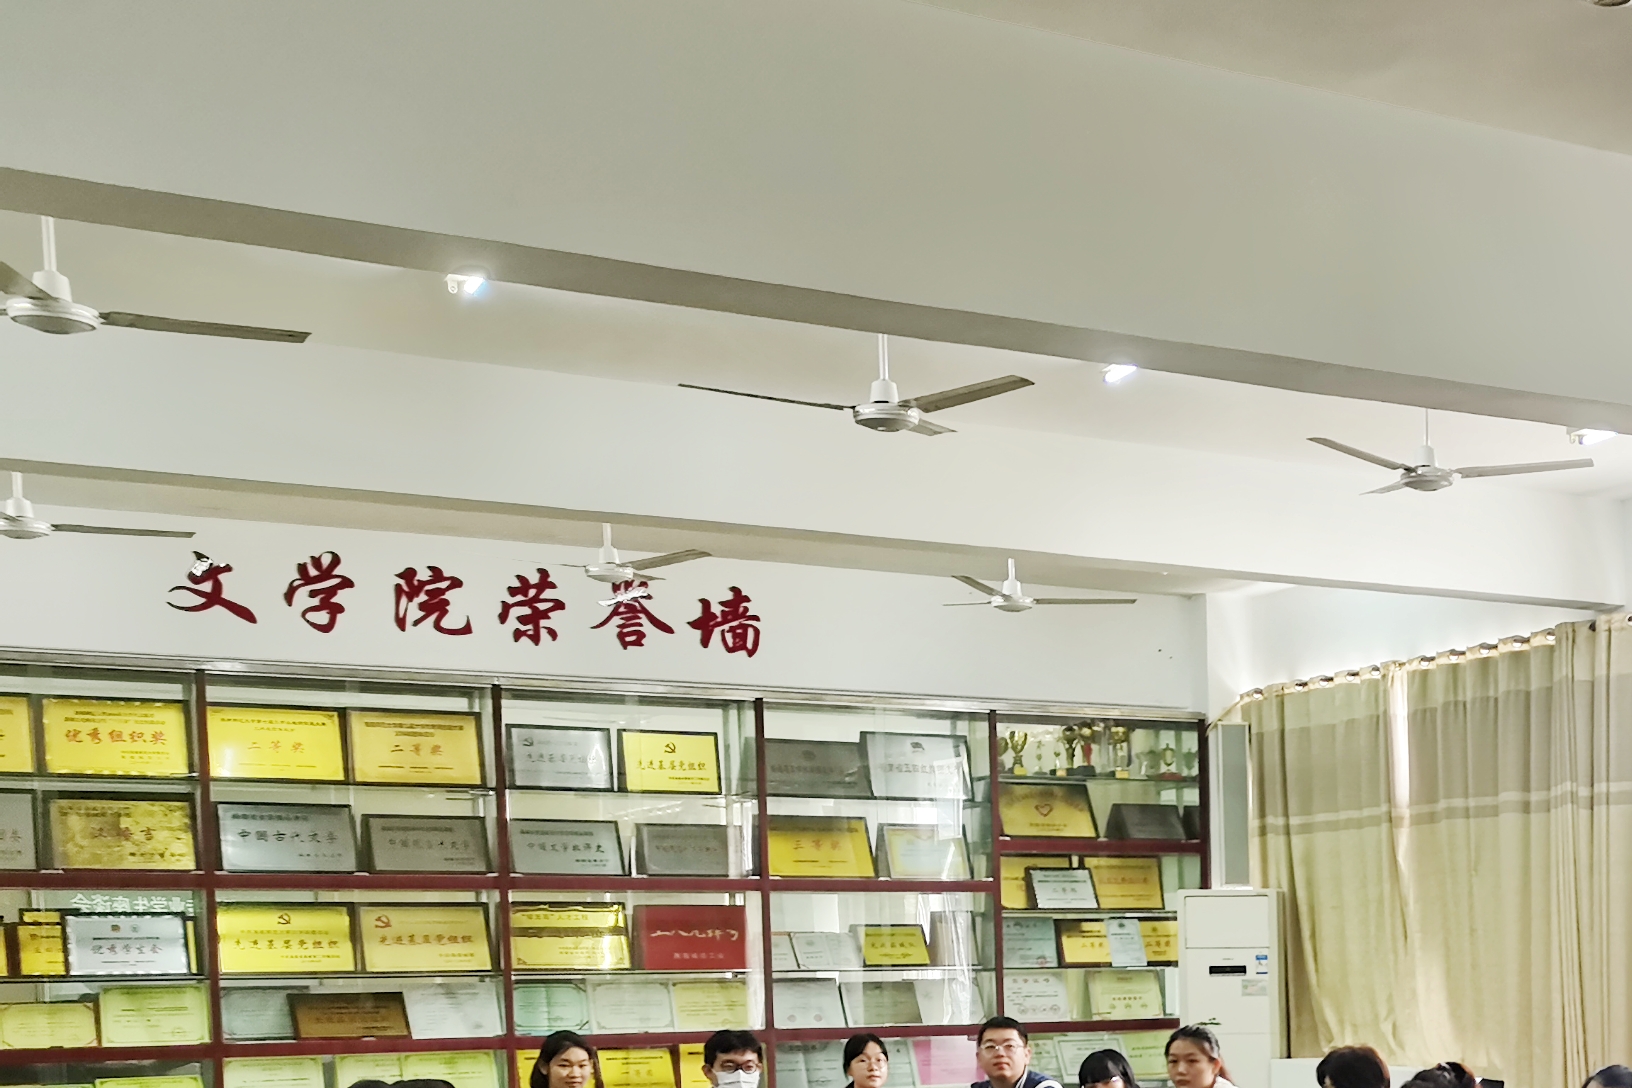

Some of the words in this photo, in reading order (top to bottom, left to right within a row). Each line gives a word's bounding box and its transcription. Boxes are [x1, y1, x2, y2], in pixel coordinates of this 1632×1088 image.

[166, 550, 761, 658] 文学院荣誉墙
[65, 727, 168, 746] 优秀组织奖
[247, 739, 306, 754] 二等奖
[389, 743, 444, 757] 二等奖
[635, 758, 708, 772] 先进基层党组织
[237, 828, 339, 844] 中国古代文学
[232, 938, 341, 951] 先进基层党组织
[378, 932, 475, 947] 先进基层党组织
